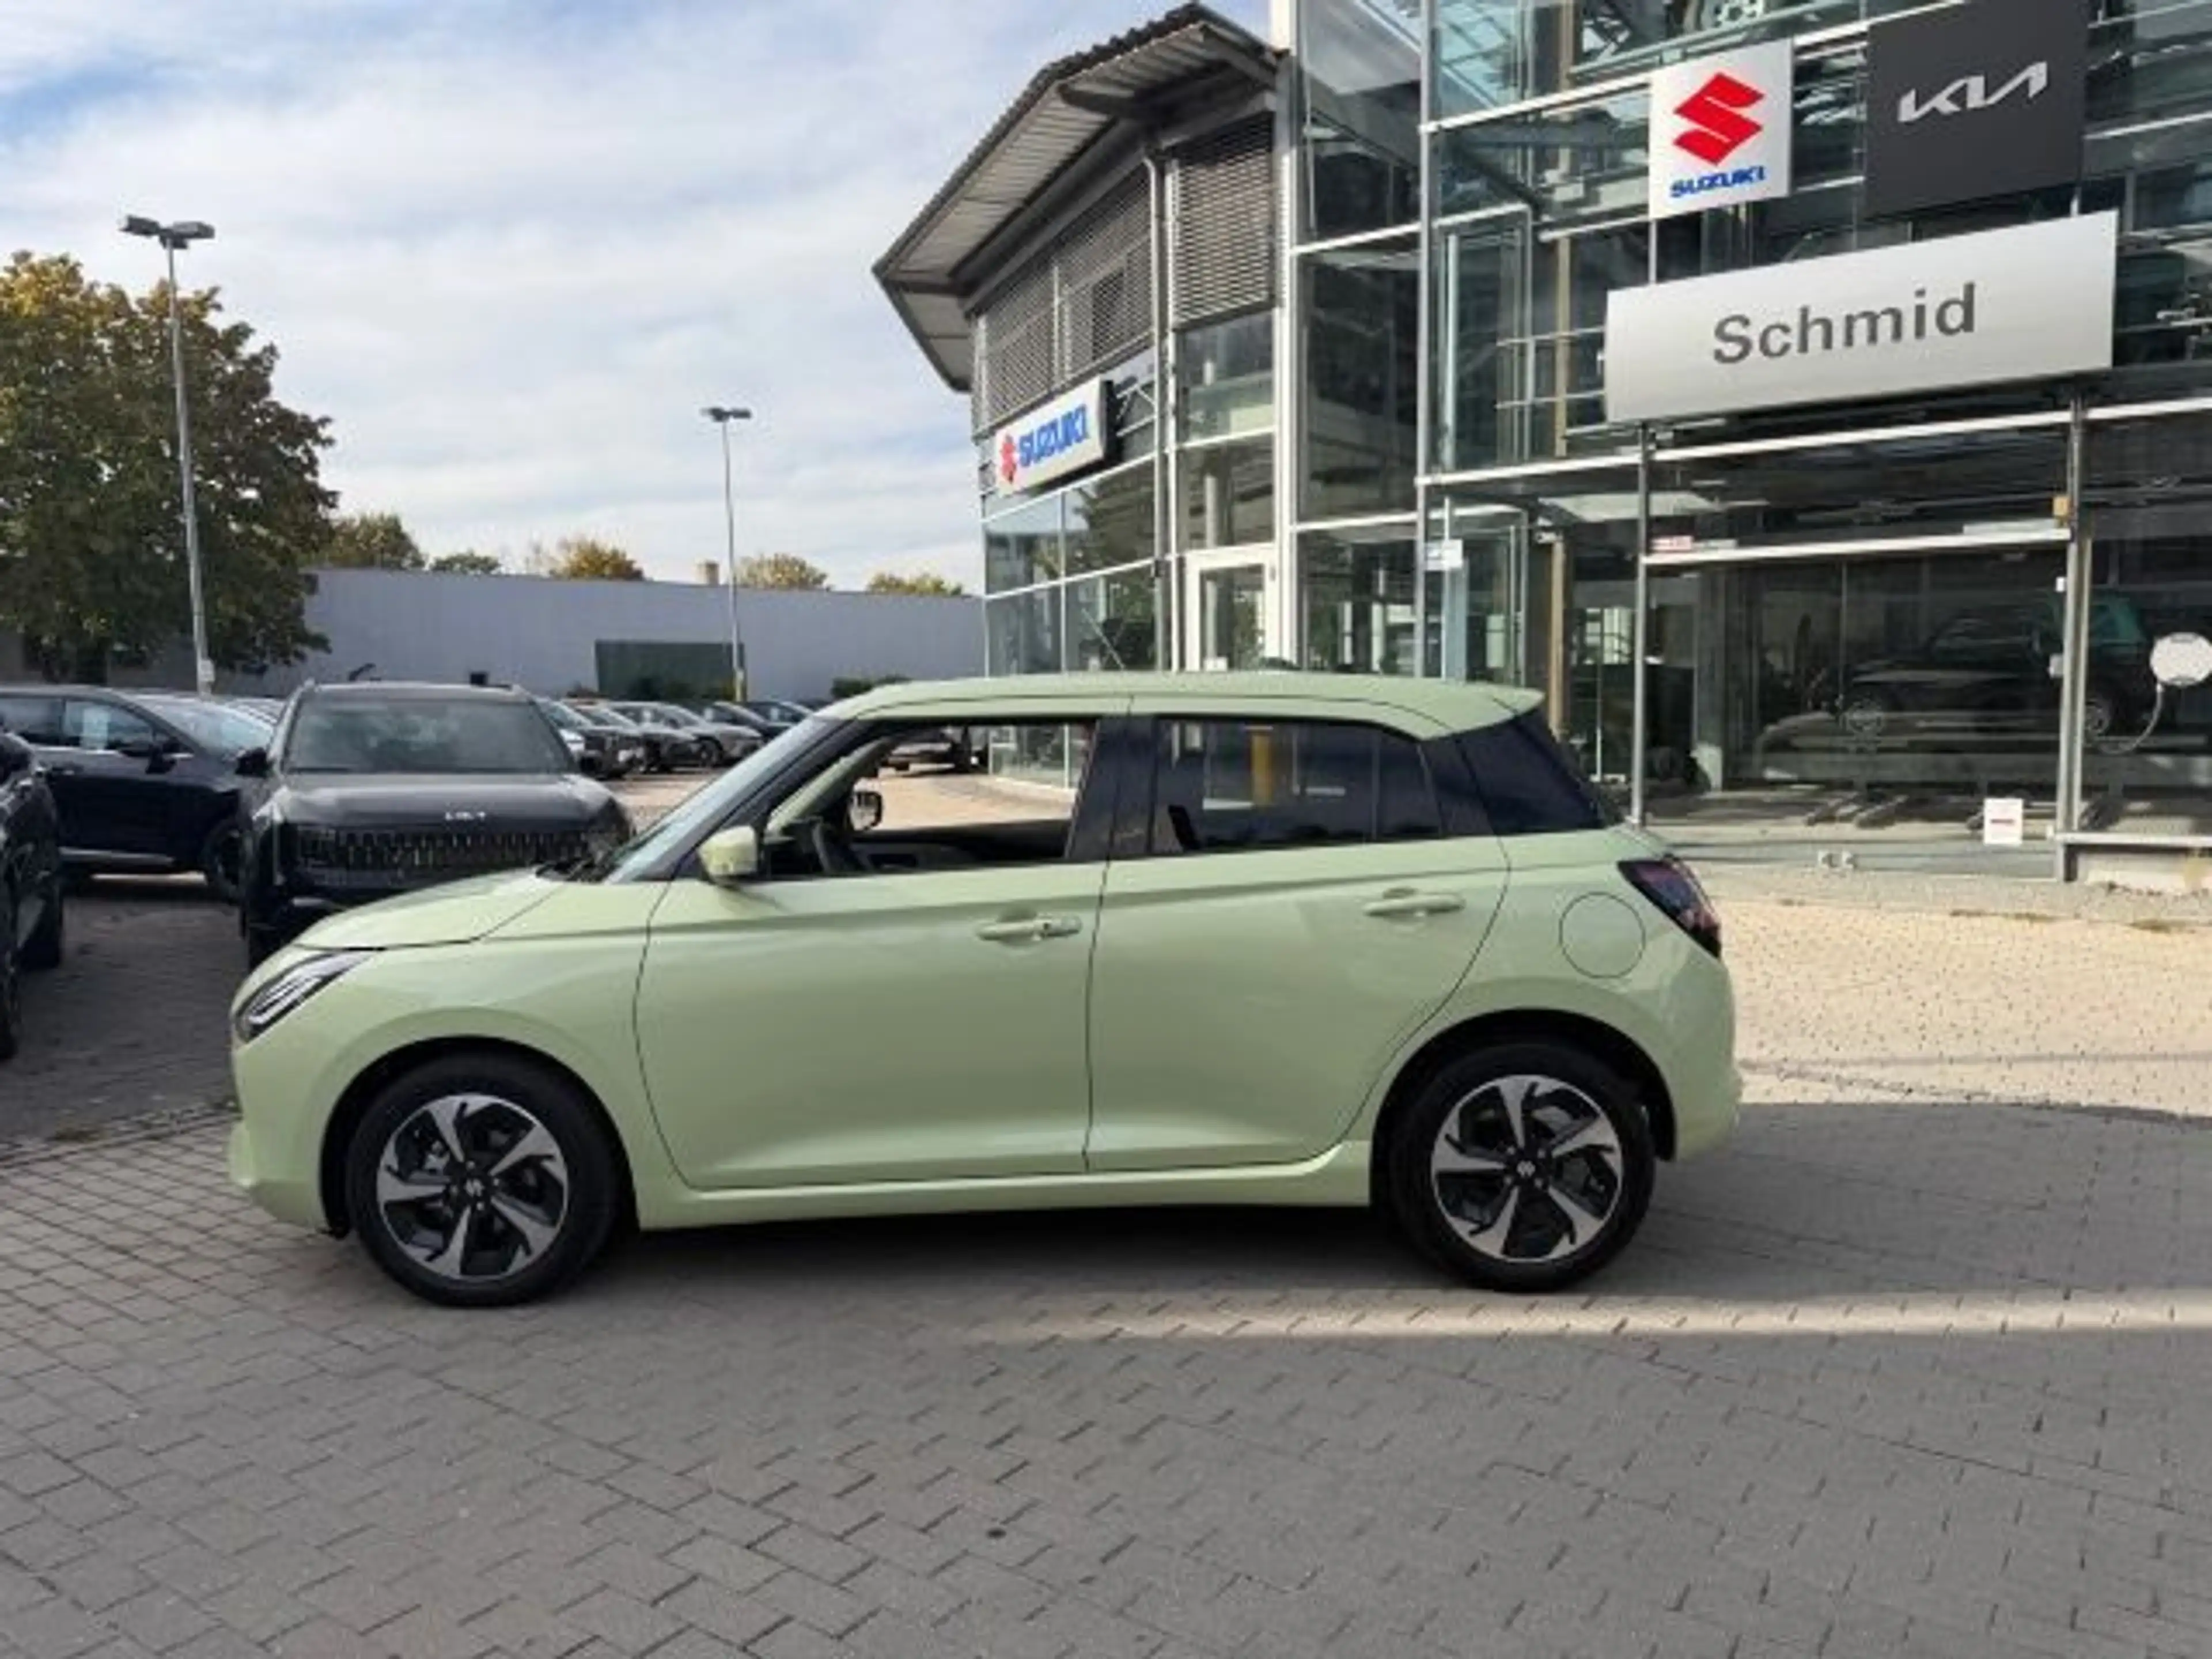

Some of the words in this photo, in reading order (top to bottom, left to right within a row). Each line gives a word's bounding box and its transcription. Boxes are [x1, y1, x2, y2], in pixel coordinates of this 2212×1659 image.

[1897, 60, 2048, 123] KIA
[1669, 165, 1767, 198] SUZUKI
[1713, 282, 1976, 365] Schmid
[1018, 405, 1089, 466] SUZUKI
